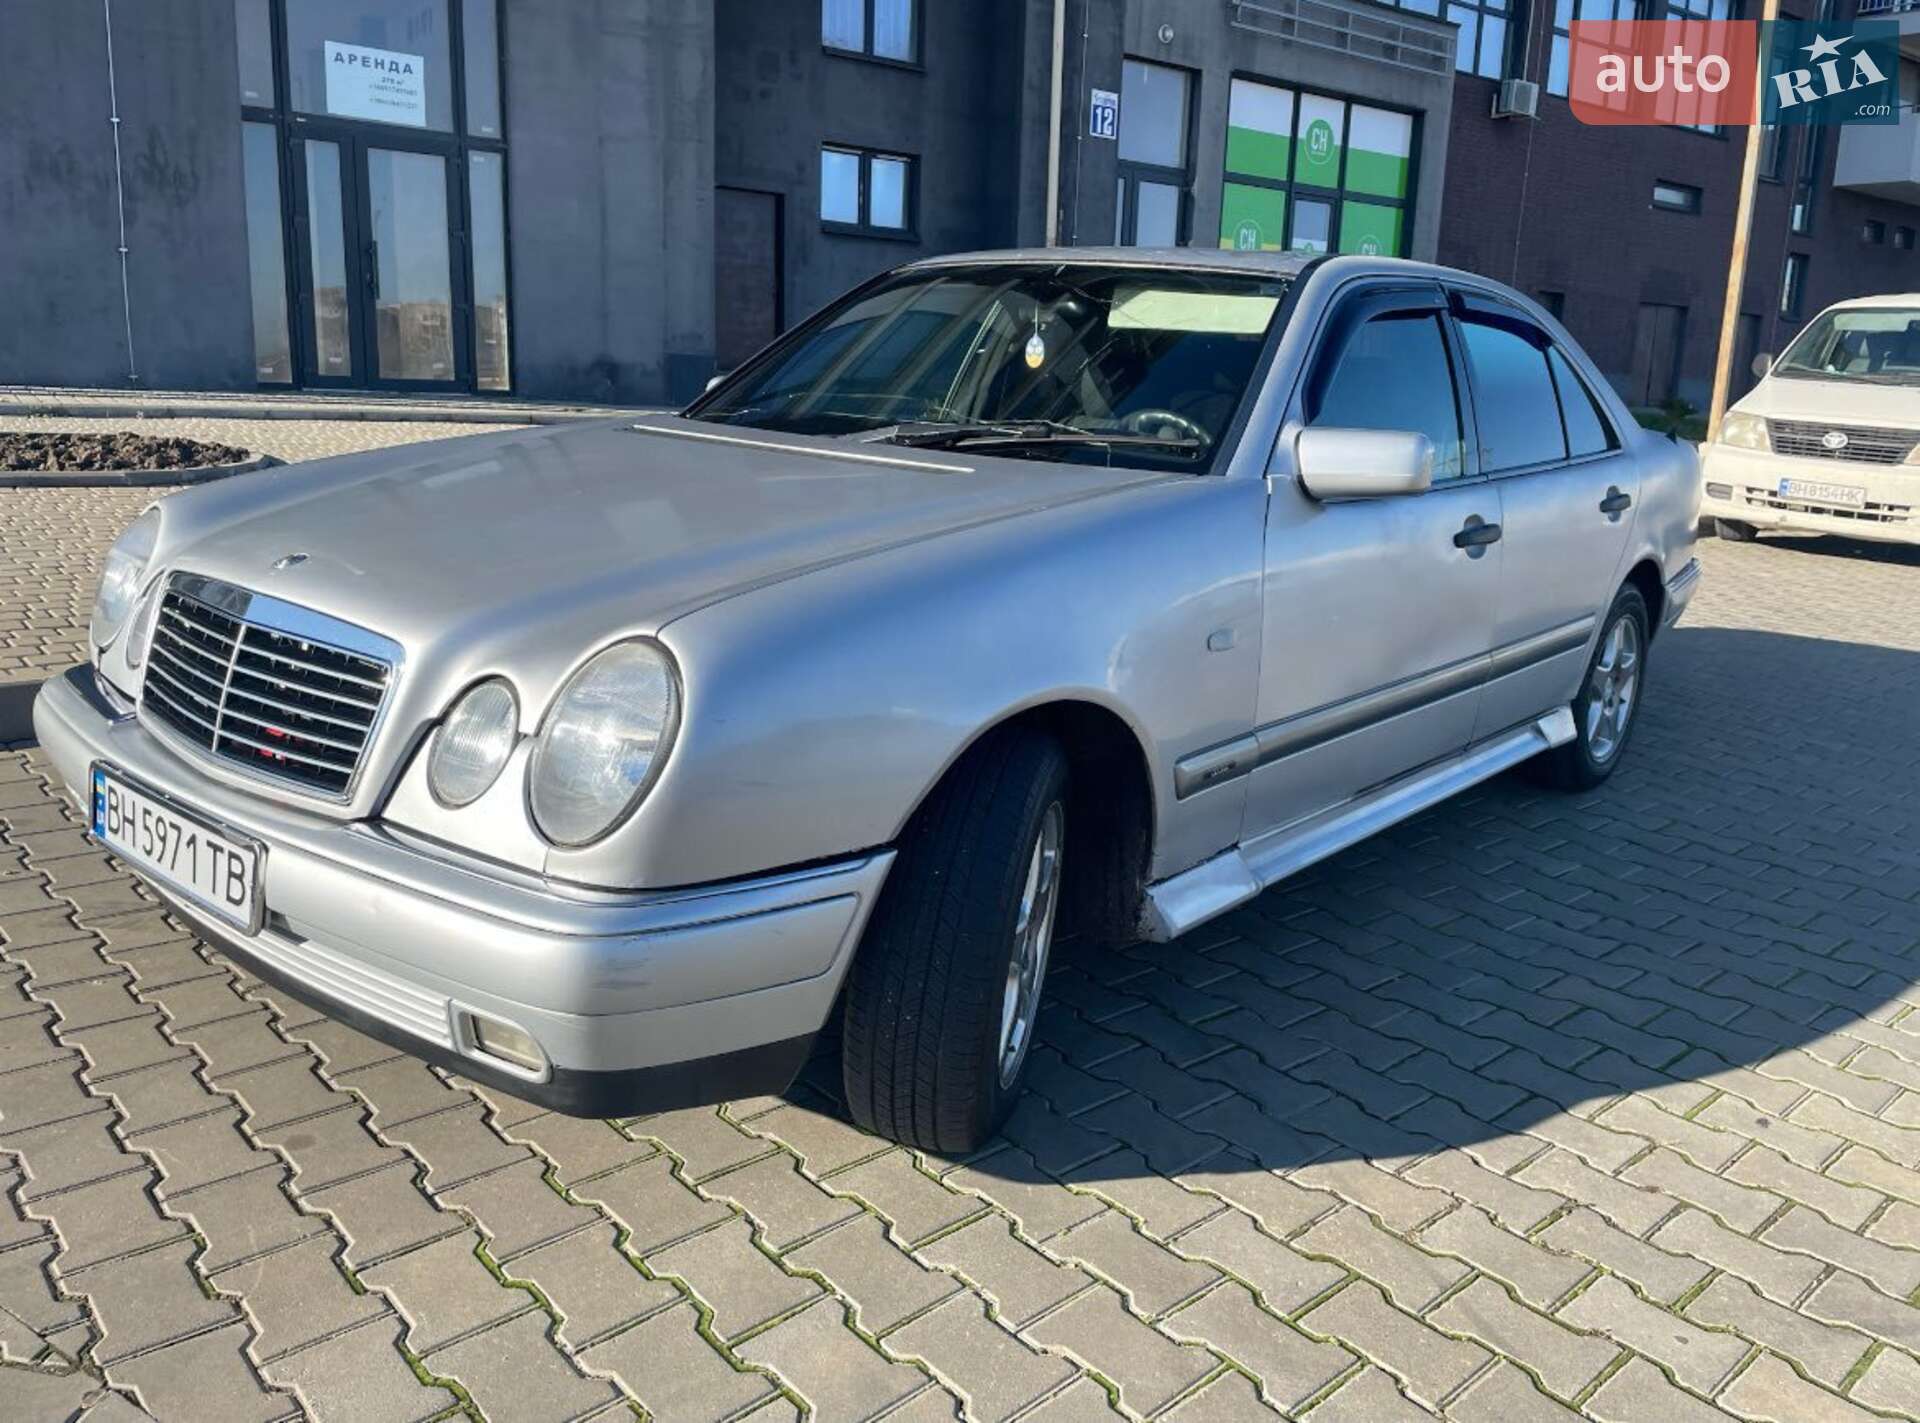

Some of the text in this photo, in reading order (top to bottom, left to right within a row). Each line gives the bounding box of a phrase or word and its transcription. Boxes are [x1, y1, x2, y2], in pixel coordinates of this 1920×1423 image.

[334, 52, 413, 74] АРЕНДА
[1095, 106, 1113, 136] 12
[108, 785, 246, 907] BH 5971 TB
